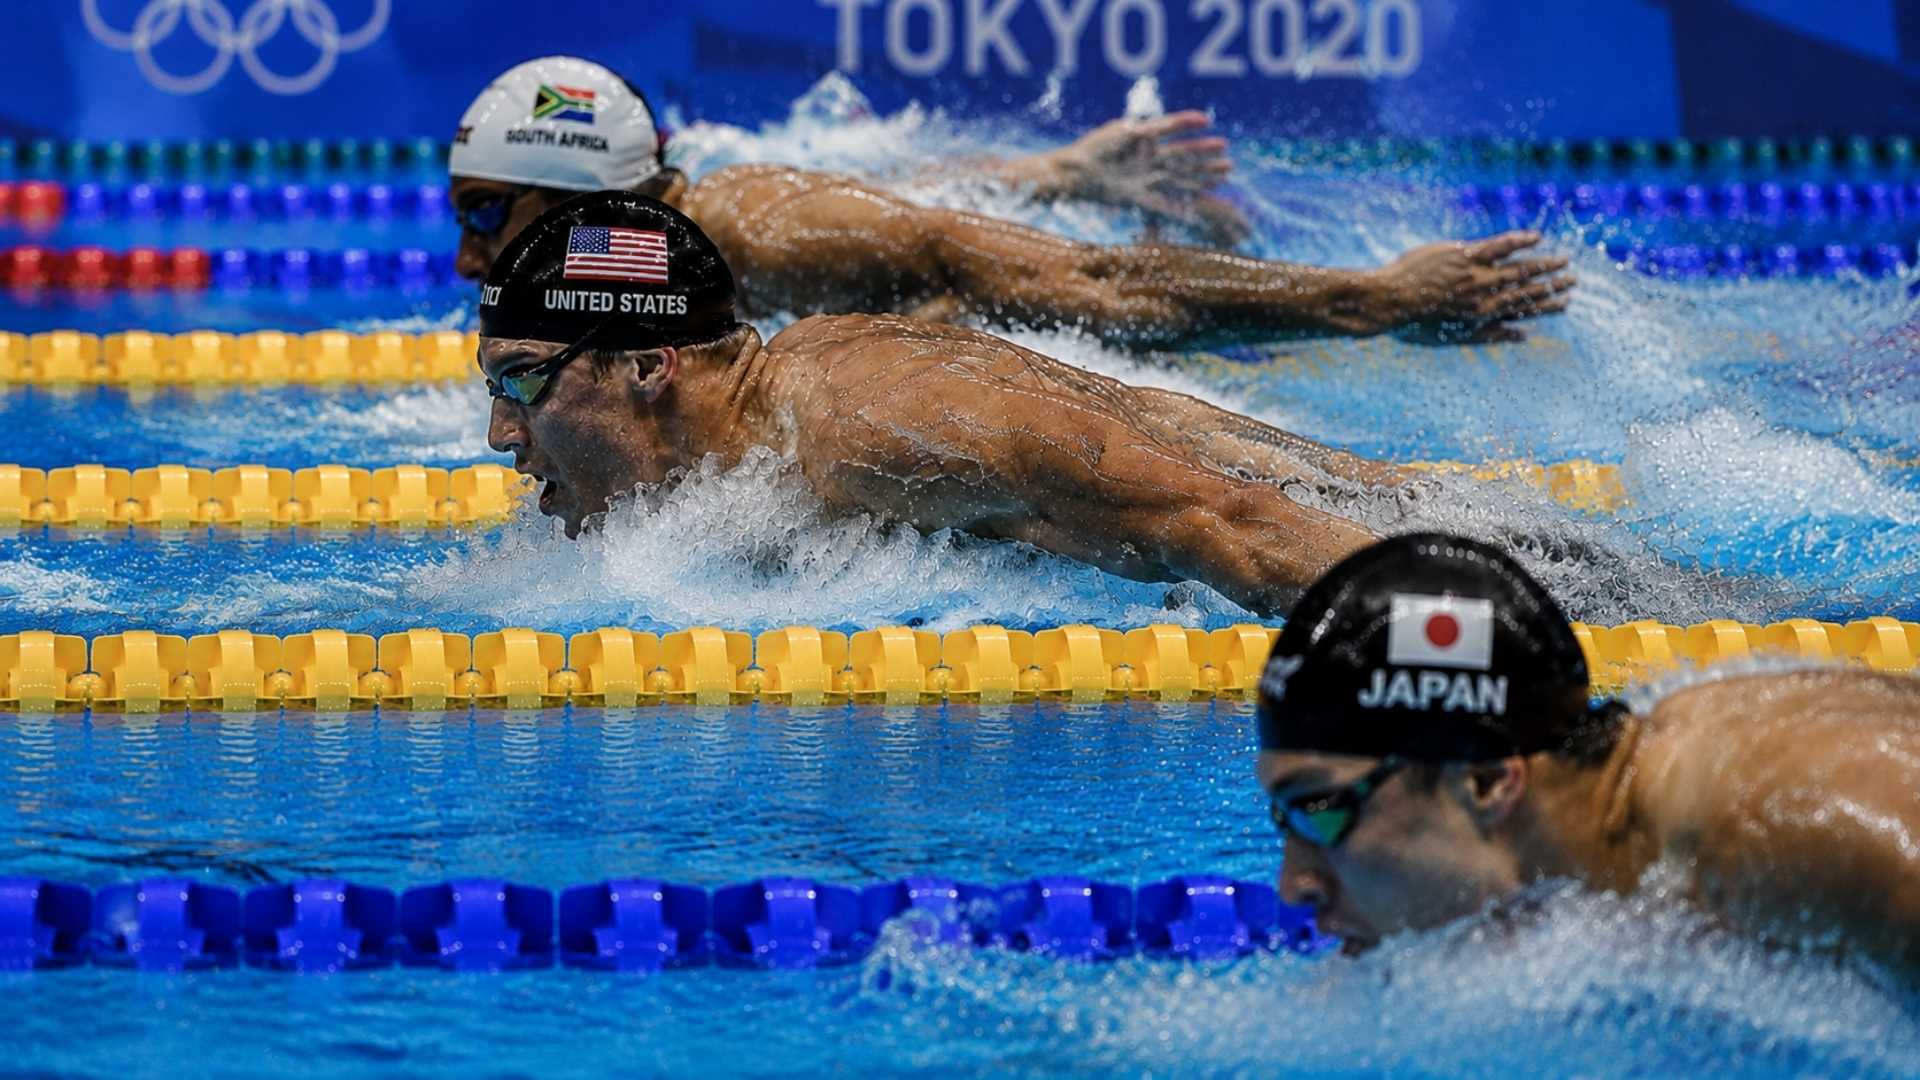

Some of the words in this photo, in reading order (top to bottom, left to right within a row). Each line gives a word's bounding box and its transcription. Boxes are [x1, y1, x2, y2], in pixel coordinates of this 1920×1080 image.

[819, 0, 1167, 75] TOKYO
[1189, 0, 1422, 77] 2020
[505, 129, 556, 145] SOUTH
[559, 131, 609, 152] AFRICA
[544, 289, 614, 312] UNITED
[620, 293, 687, 314] STATES
[1357, 668, 1508, 715] JAPAN
